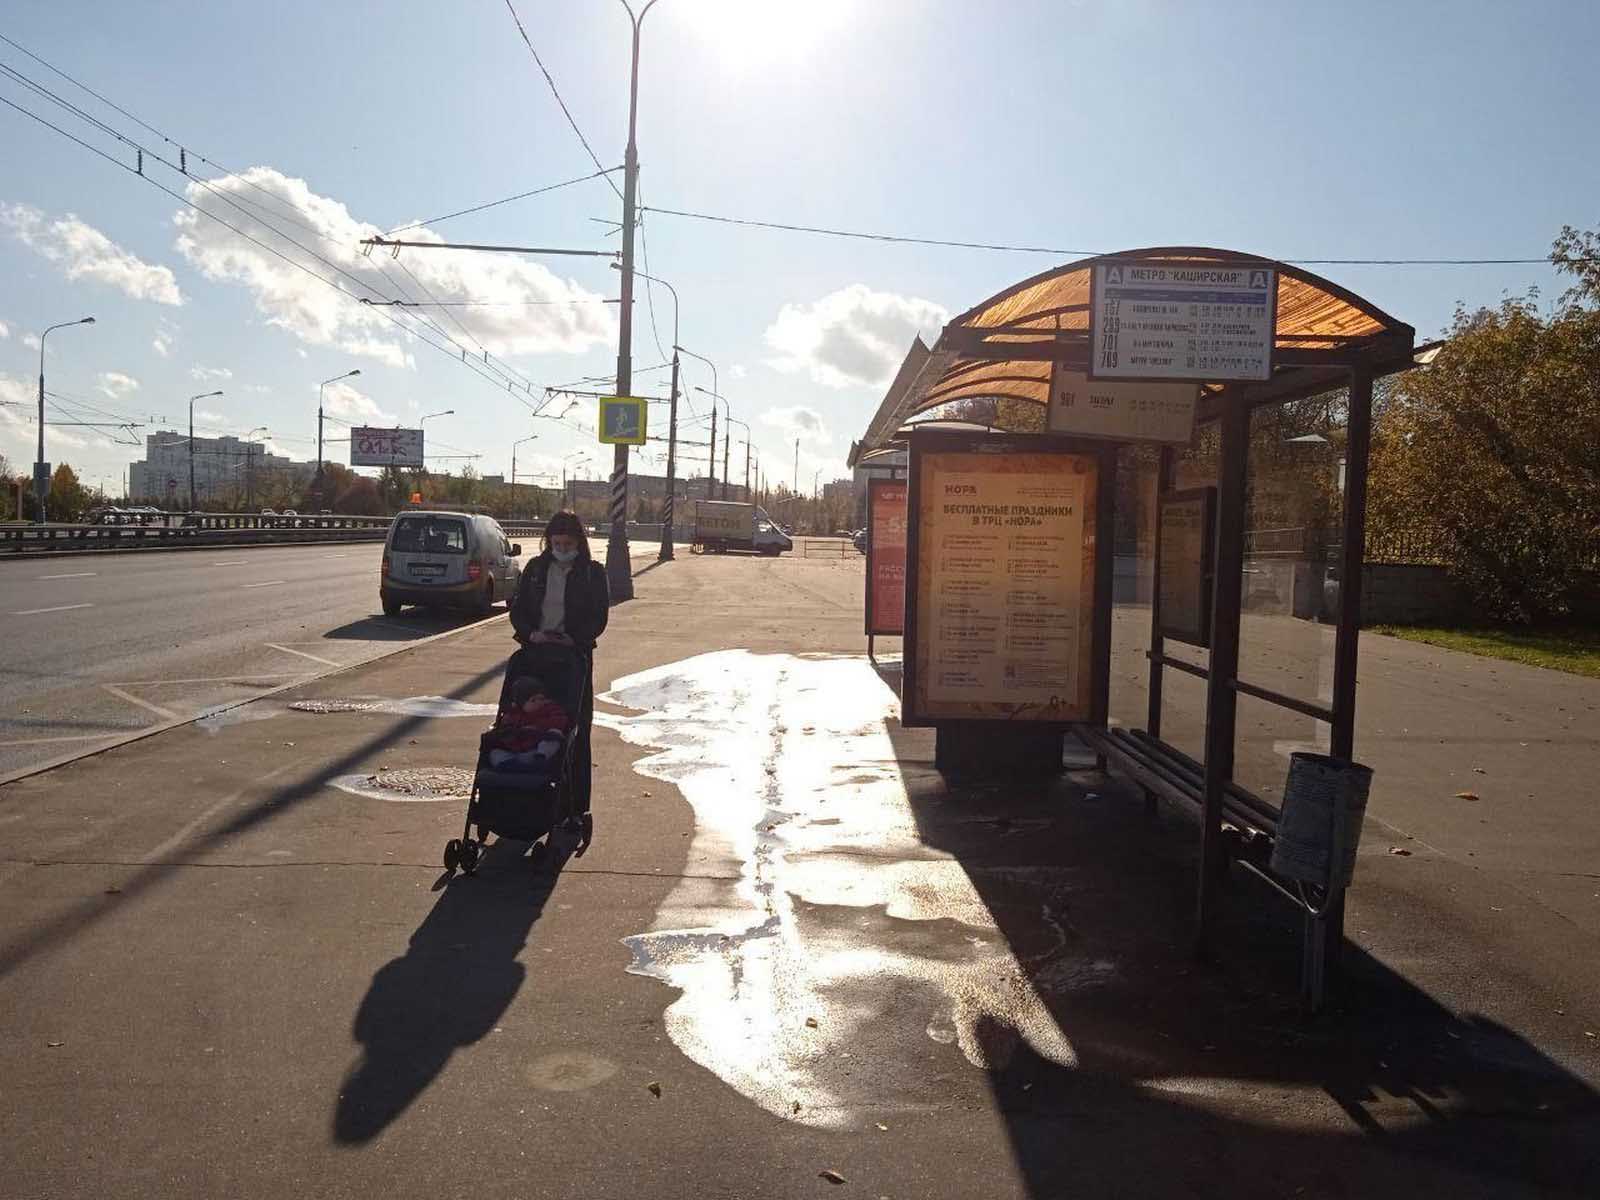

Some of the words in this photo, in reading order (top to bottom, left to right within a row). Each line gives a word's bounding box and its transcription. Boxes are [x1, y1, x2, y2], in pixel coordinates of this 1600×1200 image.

[1130, 270, 1164, 281] МЕТРО
[943, 504, 1009, 516] БЕСПЛАТНЫЕ
[1011, 505, 1073, 517] ПРАЗДНИКИ
[972, 516, 979, 526] В
[982, 516, 1003, 527] ТРЦ
